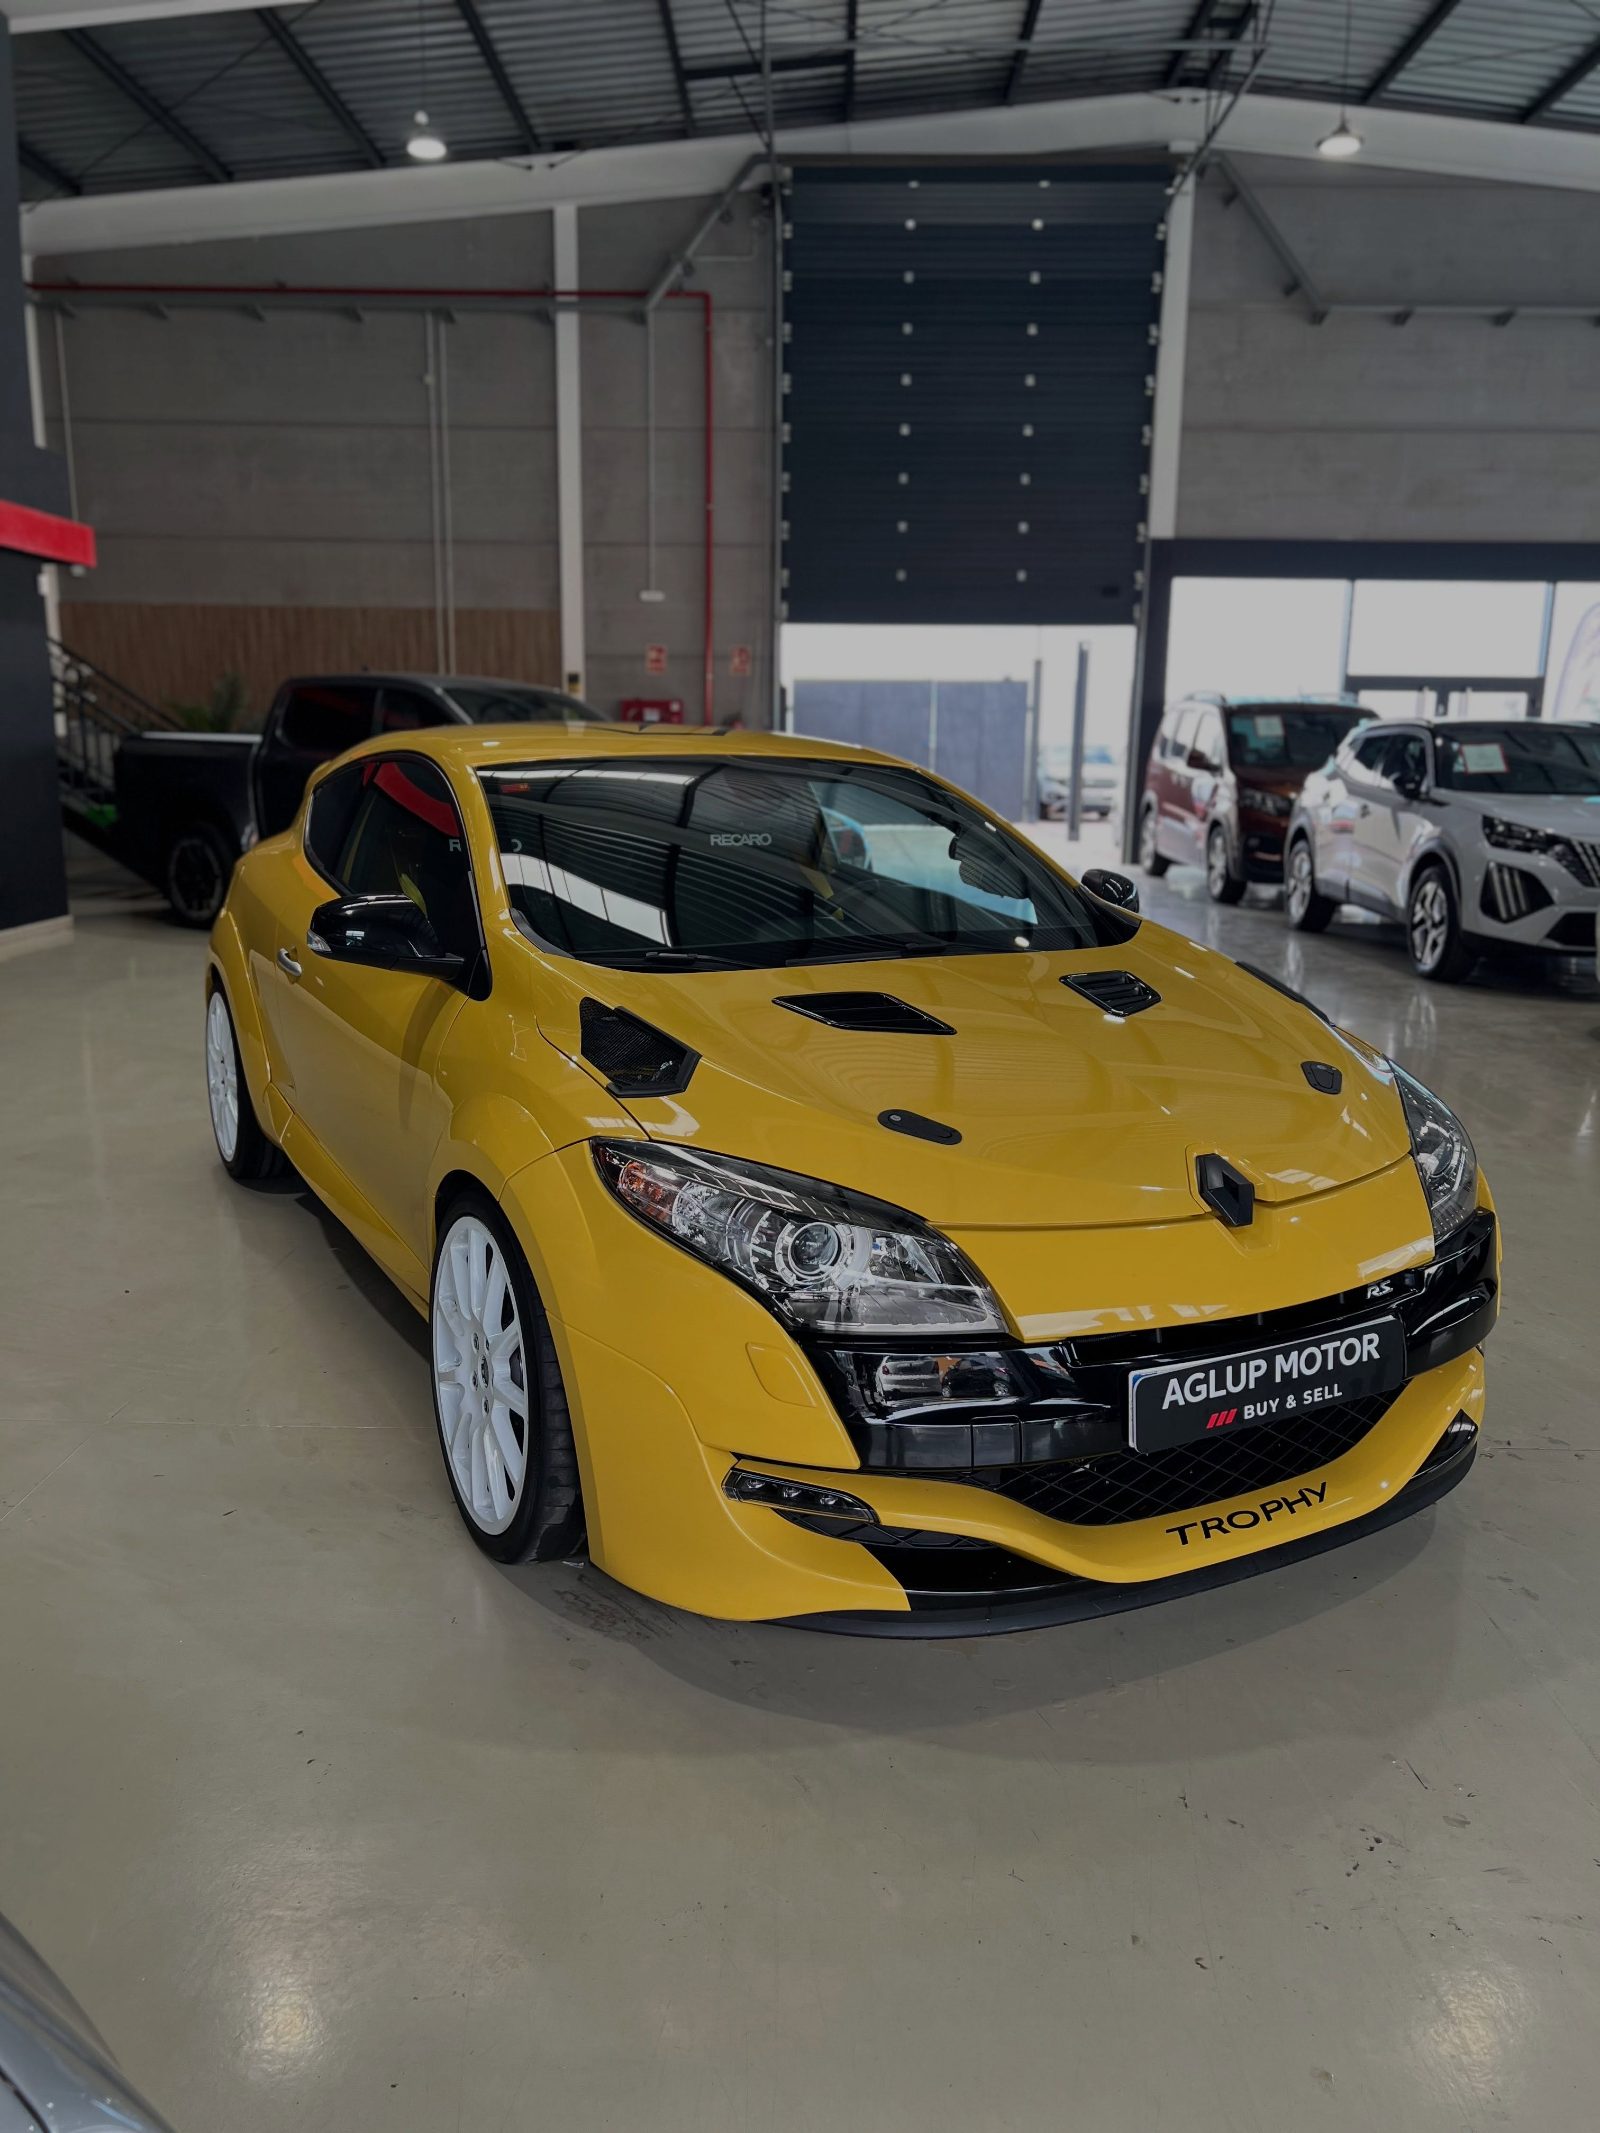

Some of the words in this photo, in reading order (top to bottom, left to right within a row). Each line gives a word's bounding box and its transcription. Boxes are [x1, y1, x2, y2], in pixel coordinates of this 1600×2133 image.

[709, 833, 772, 847] RECARO
[1162, 1359, 1268, 1410] AGLUP
[1275, 1333, 1380, 1383] MOTOR
[1243, 1398, 1280, 1420] BUY
[1285, 1394, 1298, 1409] &
[1303, 1383, 1343, 1405] SELL
[1166, 1482, 1327, 1545] TROPHY
